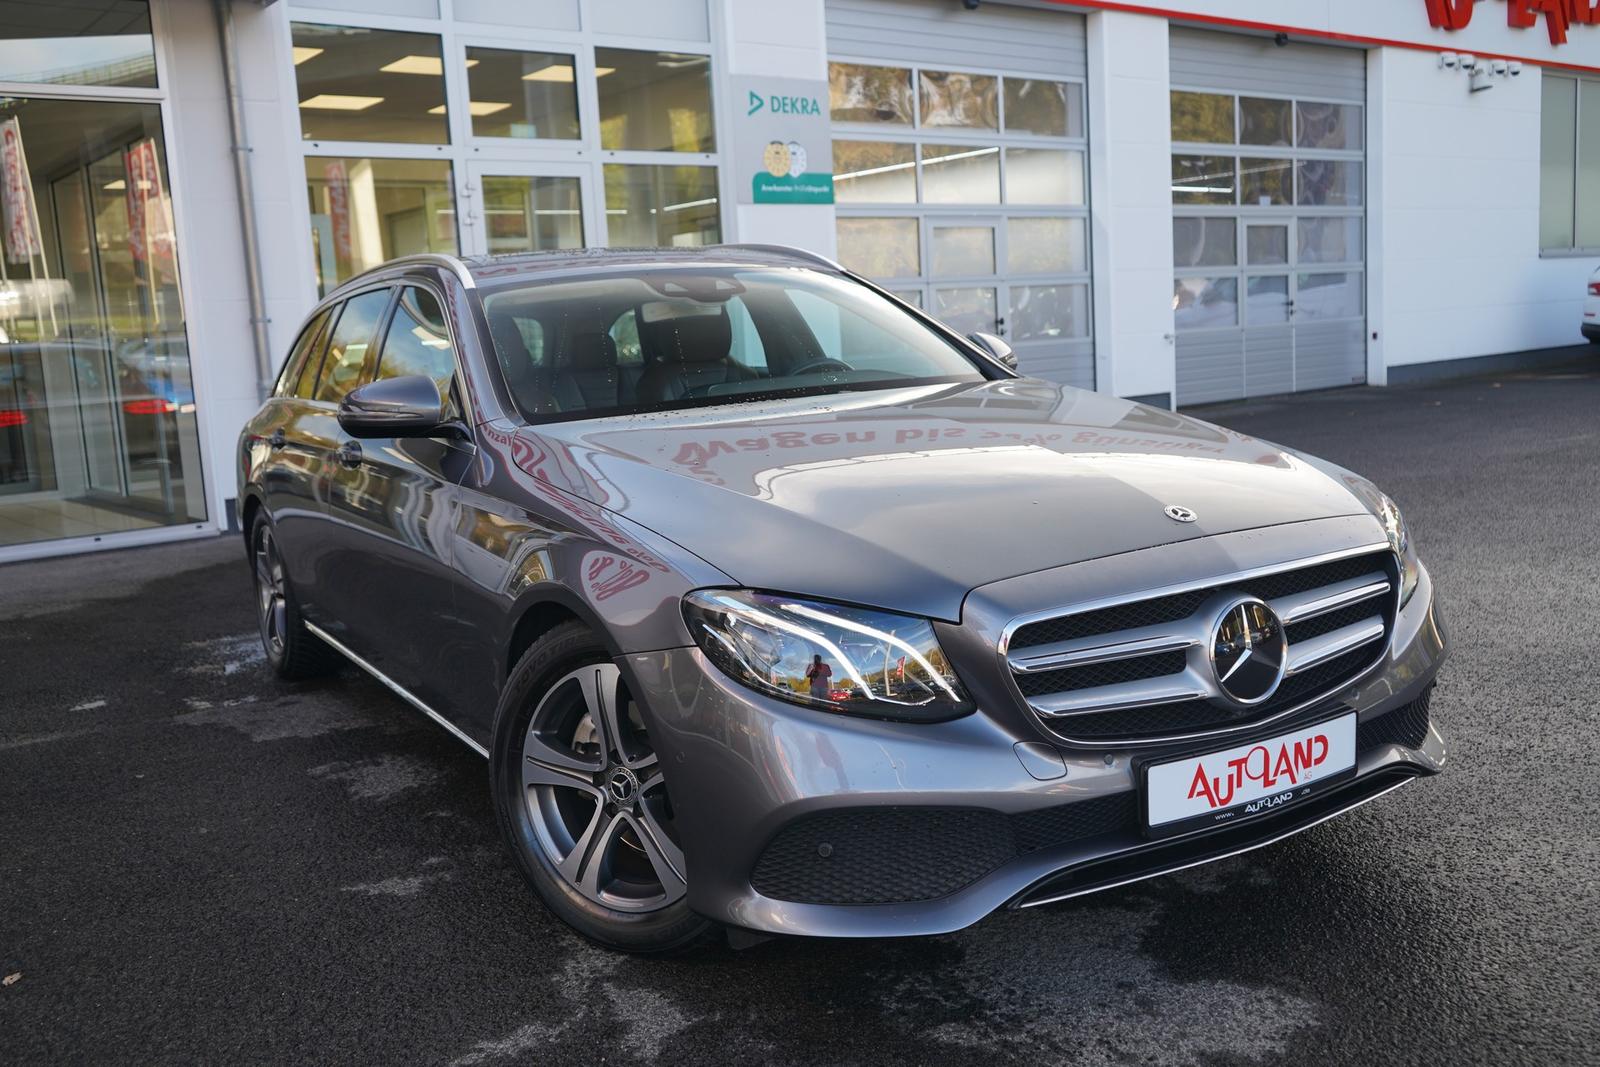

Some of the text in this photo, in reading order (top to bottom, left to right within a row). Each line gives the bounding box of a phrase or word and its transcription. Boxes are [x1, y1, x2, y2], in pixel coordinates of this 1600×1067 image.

[770, 95, 821, 115] DEKRA
[1187, 734, 1329, 808] AUTOLAND
[1244, 792, 1293, 813] AUTOLAND
